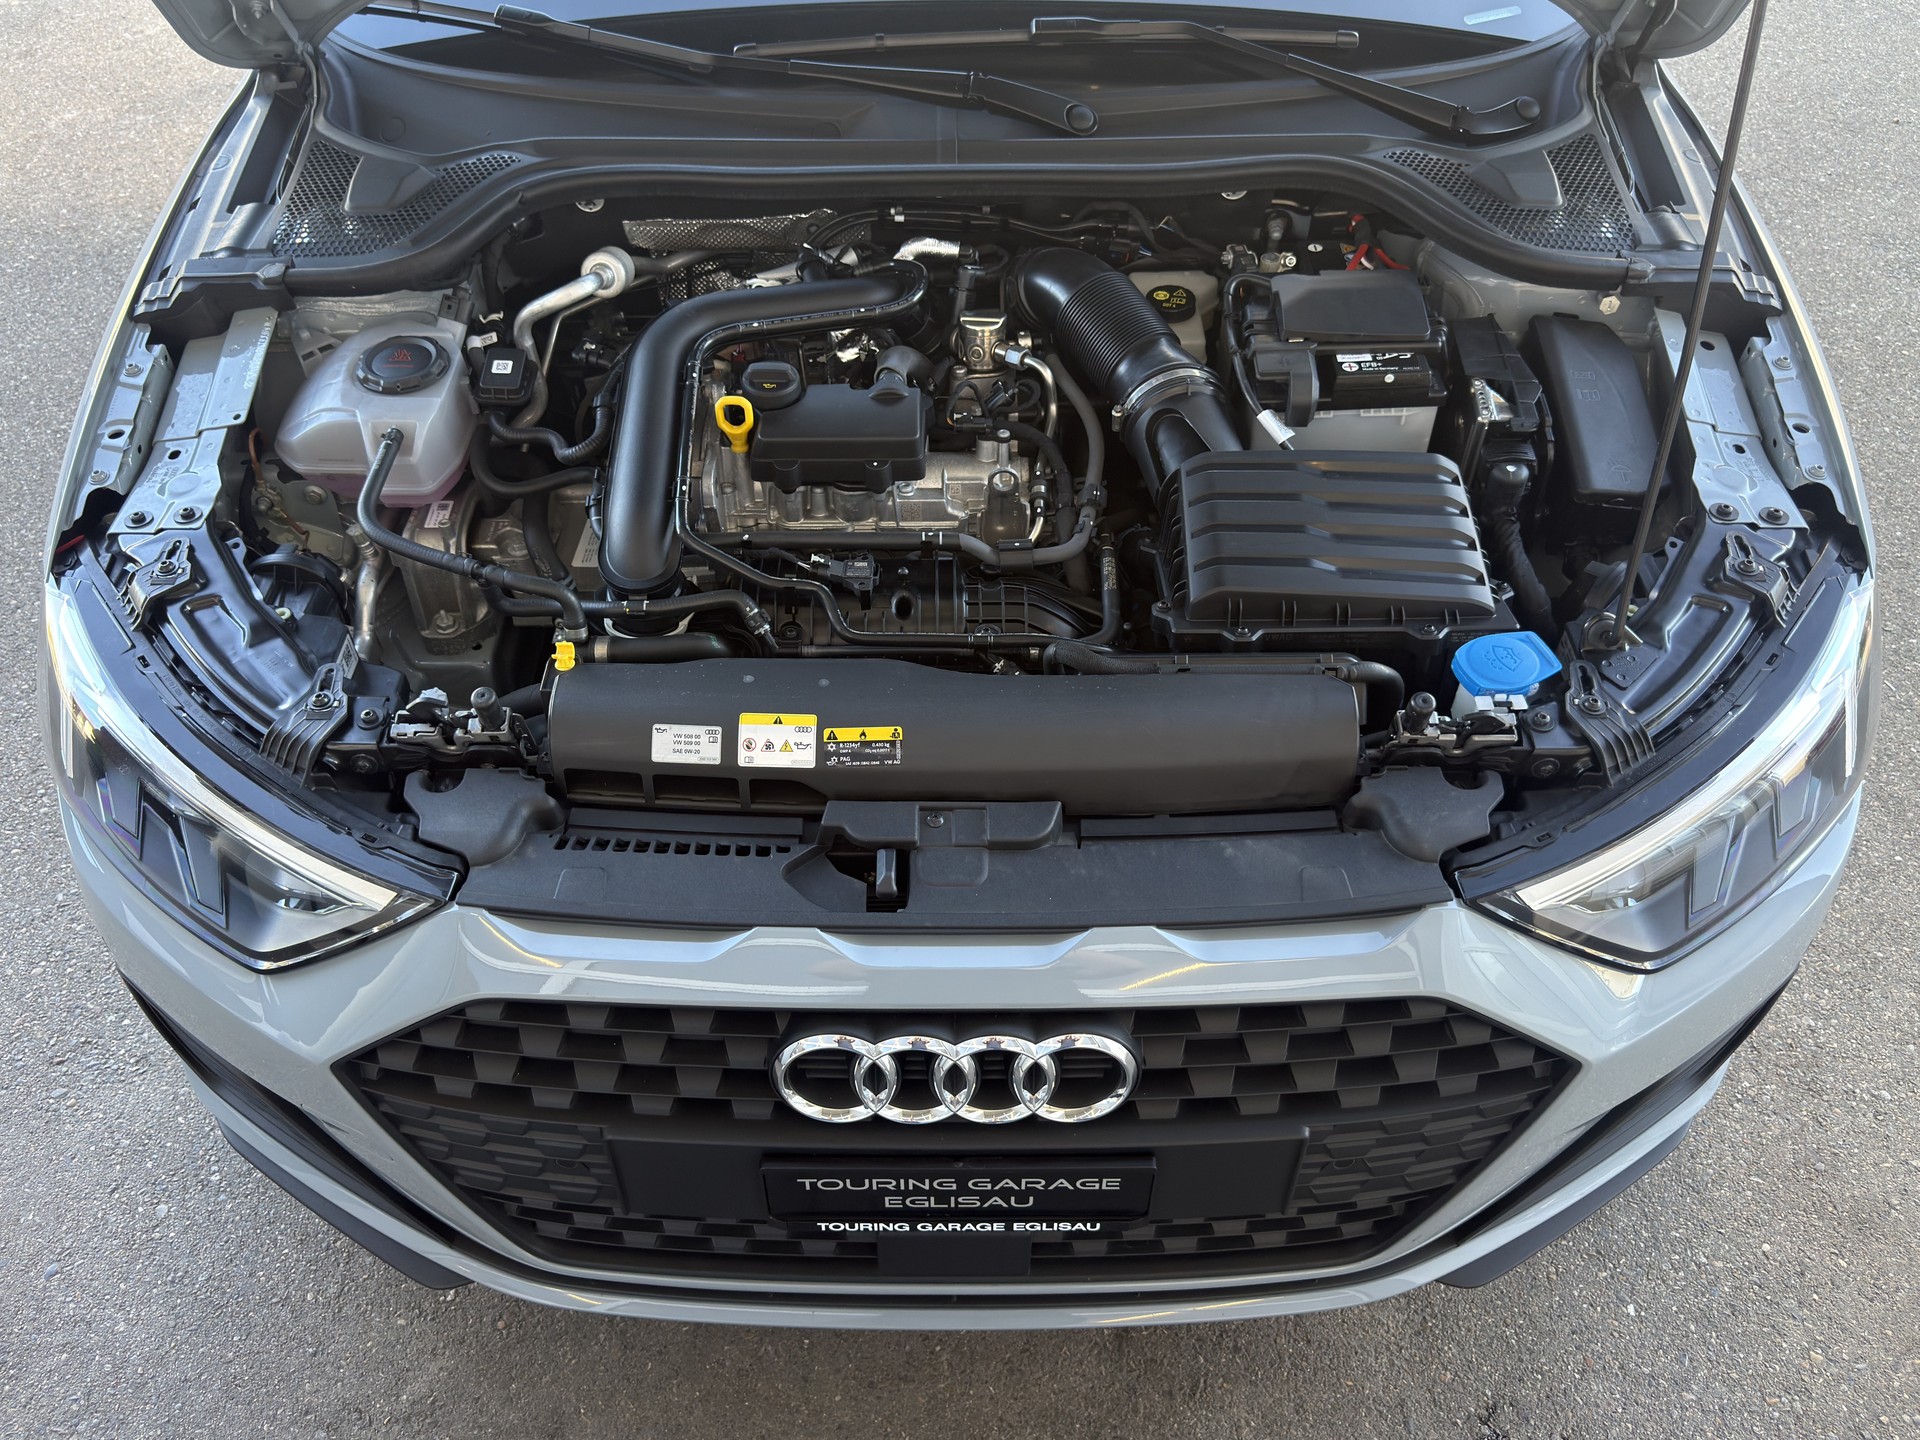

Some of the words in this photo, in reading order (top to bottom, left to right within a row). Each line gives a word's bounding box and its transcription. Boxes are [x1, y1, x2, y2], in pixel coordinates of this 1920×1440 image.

[797, 1178, 957, 1191] TOURING
[967, 1178, 1122, 1191] GARAGE
[884, 1196, 1035, 1208] EGLISAU
[817, 1222, 910, 1232] TOURING
[916, 1222, 1005, 1232] GARAGE
[1012, 1222, 1101, 1232] EGLISAU
